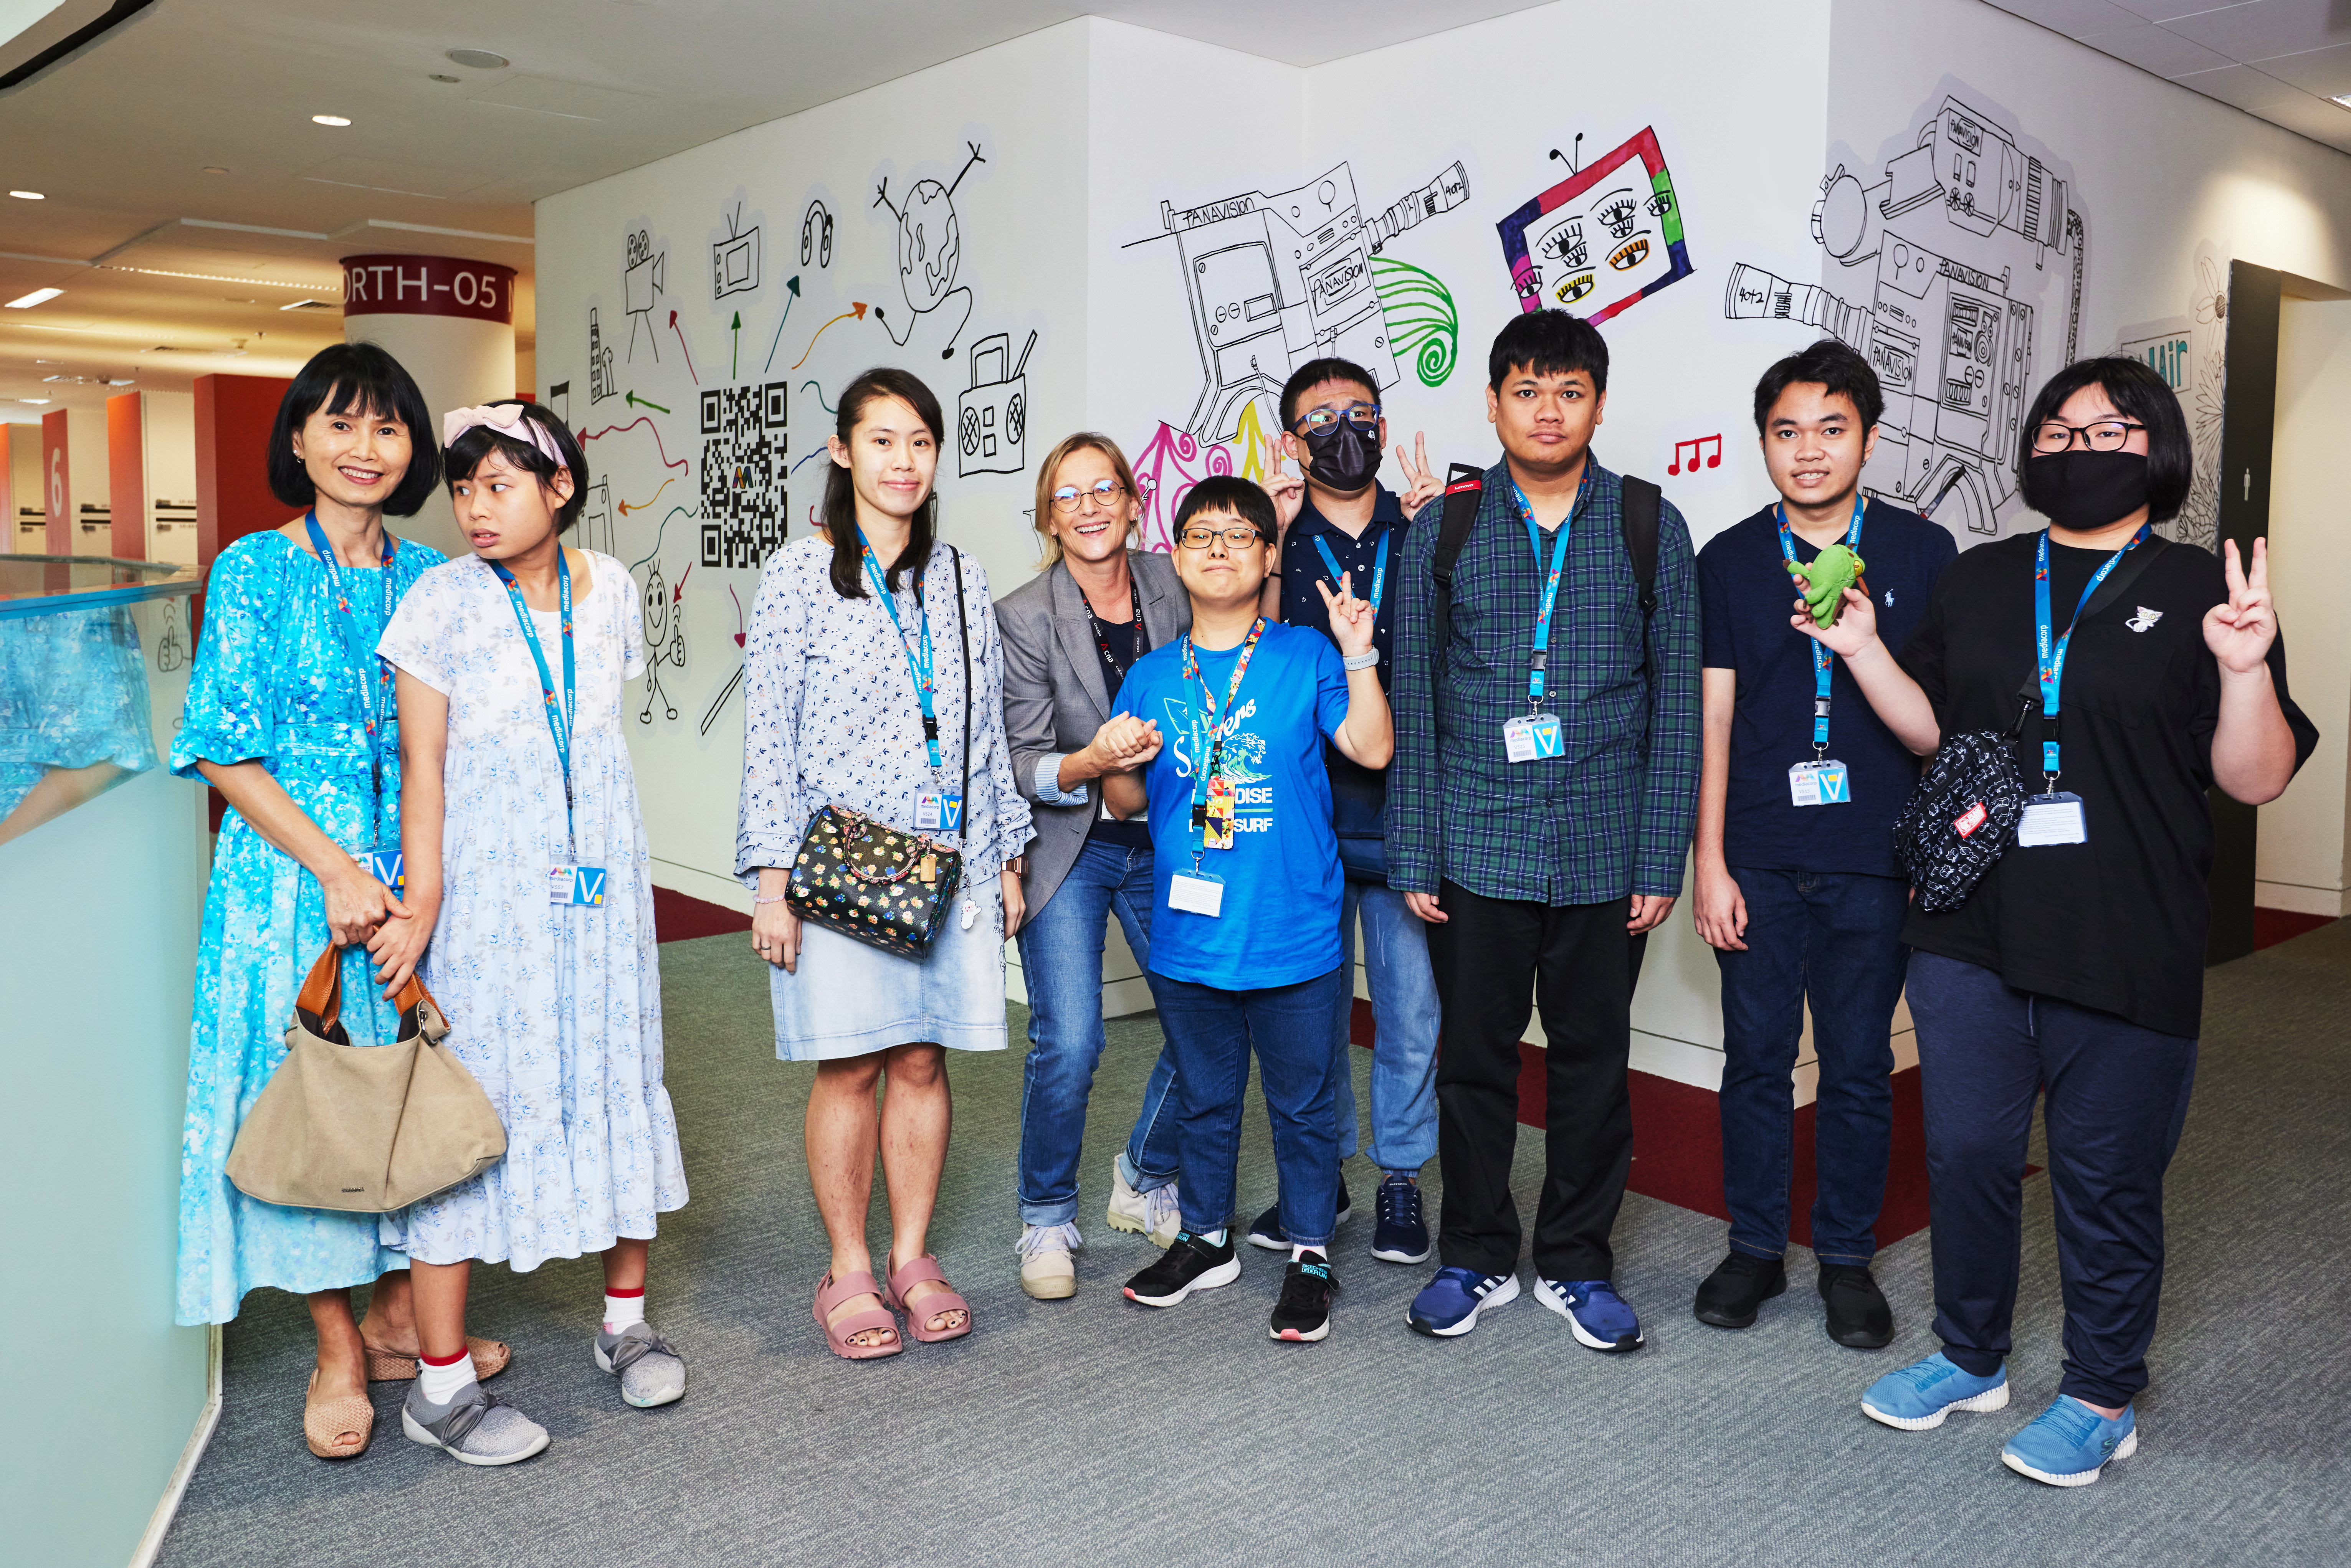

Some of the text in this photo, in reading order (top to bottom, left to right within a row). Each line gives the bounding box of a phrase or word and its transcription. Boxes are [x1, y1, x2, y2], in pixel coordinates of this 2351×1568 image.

[344, 266, 496, 308] ORTH-05
[1312, 263, 1363, 303] PANAVISION
[1939, 258, 1989, 291] PANAVISION
[1873, 346, 1912, 381] PANAVISION
[2159, 339, 2187, 389] Air
[51, 448, 62, 517] 6
[1785, 540, 1794, 562] mediac
[2096, 550, 2122, 582] mediacorp
[322, 550, 341, 587] mediacorp
[870, 563, 886, 595] mediacorp
[1374, 568, 1384, 598] mediacorp
[384, 577, 392, 616] mediacorp
[516, 601, 534, 638] mediacorp
[1104, 650, 1114, 663] cna
[2039, 625, 2048, 659] mediacorp
[359, 668, 371, 709] mediacorp
[1116, 666, 1124, 680] cna.asia
[552, 715, 565, 753] mediacorp
[1191, 720, 1200, 753] mediacorp
[1534, 725, 1557, 755] V
[1200, 746, 1210, 782] mediacorp
[1820, 772, 1843, 800] V
[943, 799, 962, 827] V
[1233, 818, 1273, 833] SURF
[374, 854, 402, 886] V
[578, 871, 604, 902] V
[1302, 1264, 1327, 1274] SKECHERS
